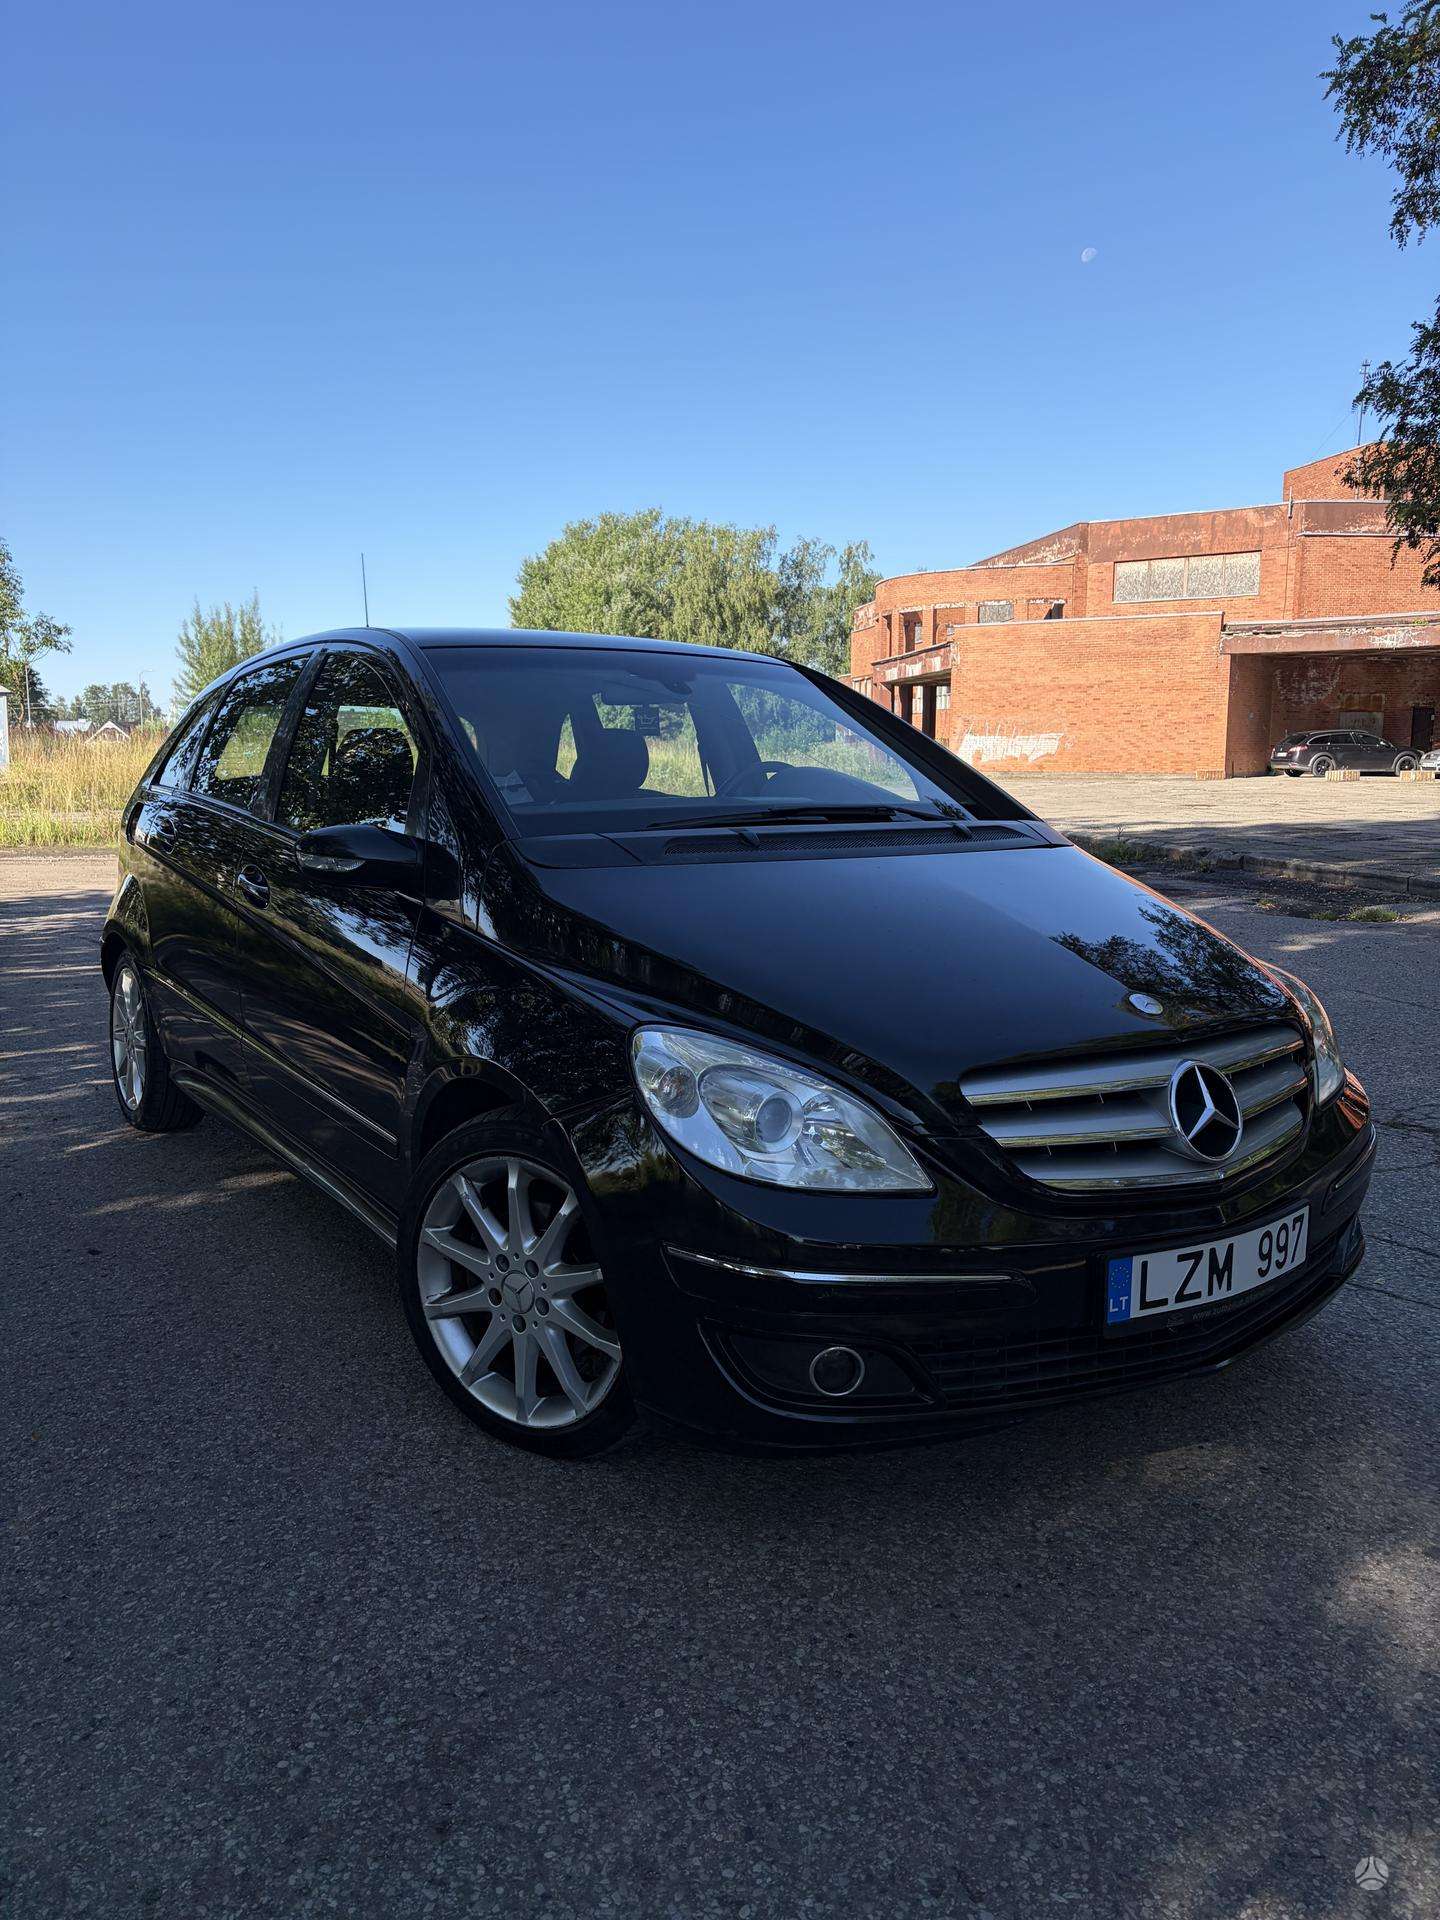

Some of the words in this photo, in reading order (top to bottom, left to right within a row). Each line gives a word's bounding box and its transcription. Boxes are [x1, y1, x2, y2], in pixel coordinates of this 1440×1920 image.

[1139, 1242, 1234, 1311] LZM
[1257, 1212, 1305, 1278] 997
[1109, 1295, 1129, 1313] LT
